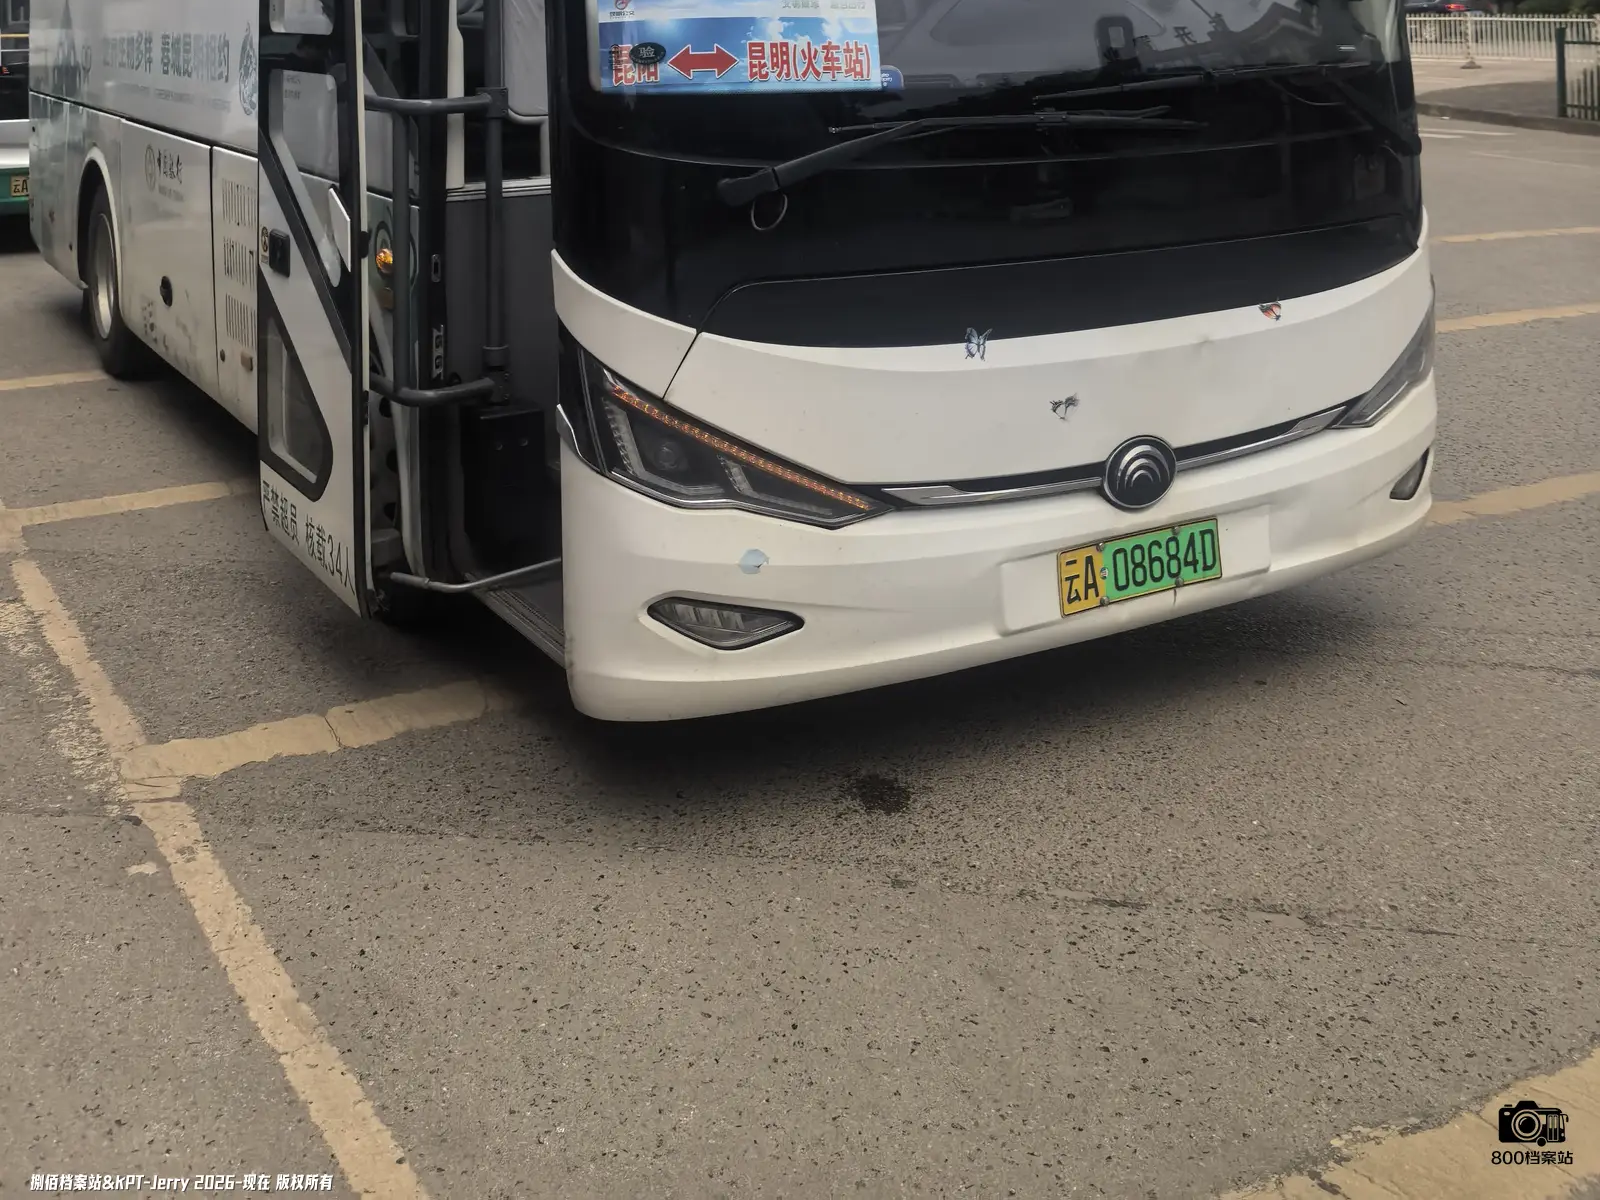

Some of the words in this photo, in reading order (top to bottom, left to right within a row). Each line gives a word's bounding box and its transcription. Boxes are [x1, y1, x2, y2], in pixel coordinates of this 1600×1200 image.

[746, 40, 872, 83] 昆明(火车站)
[262, 480, 299, 547] 严禁超员
[305, 513, 356, 596] 核载34人
